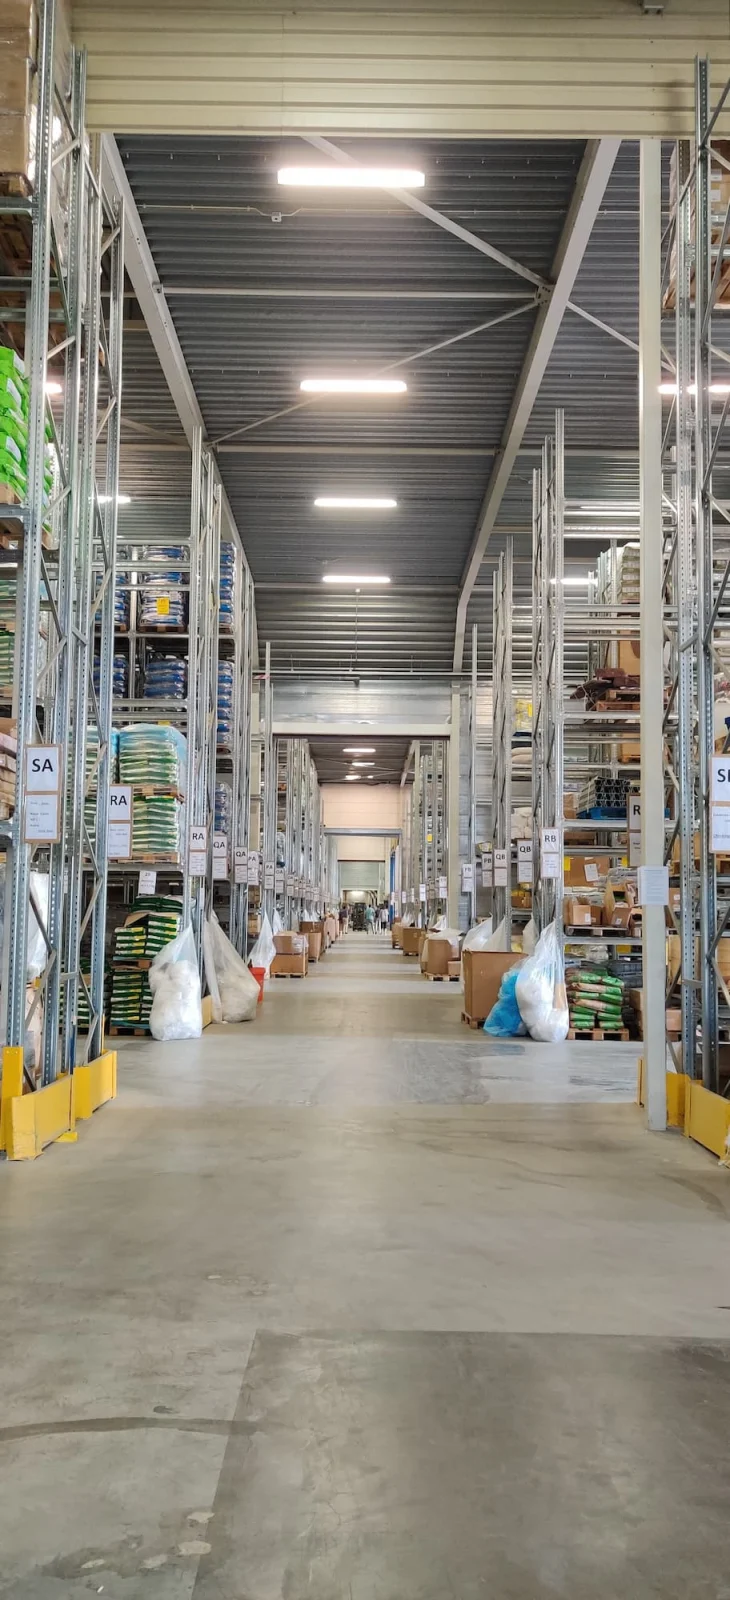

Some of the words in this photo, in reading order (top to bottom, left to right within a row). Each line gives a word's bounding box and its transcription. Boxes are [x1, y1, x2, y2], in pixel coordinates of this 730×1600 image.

[32, 758, 53, 772] SA
[717, 768, 730, 784] S
[110, 795, 128, 806] RA
[192, 832, 205, 841] RA
[544, 835, 557, 843] RB
[519, 845, 532, 854] QB
[495, 853, 506, 861] QB
